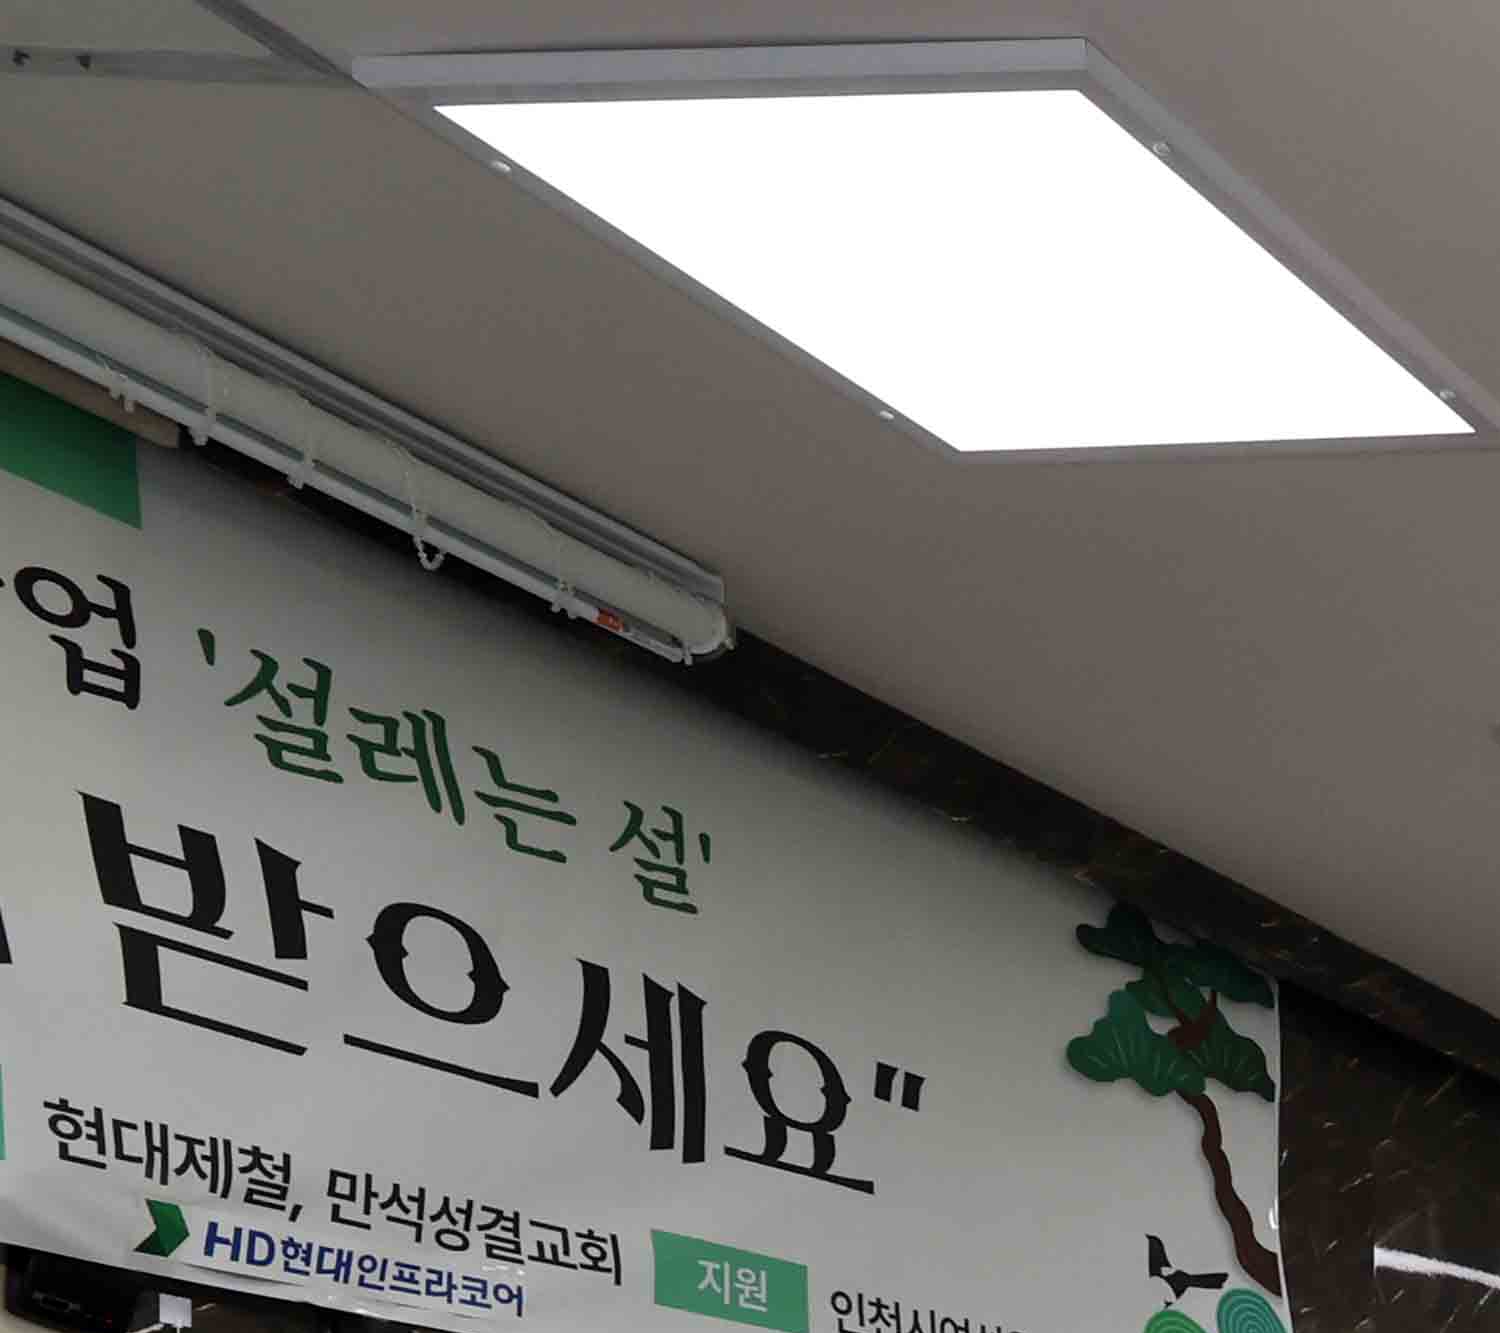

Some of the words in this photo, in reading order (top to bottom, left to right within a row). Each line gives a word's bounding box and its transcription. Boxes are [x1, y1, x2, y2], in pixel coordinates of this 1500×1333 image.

[0, 566, 141, 710] 업
[197, 627, 577, 863] '설레는
[609, 800, 711, 914] 설'
[76, 790, 927, 1195] 받으세요"
[42, 1096, 303, 1222] 현대제철,
[326, 1169, 623, 1286] 만석성결교회
[203, 1220, 526, 1317] HD현대인프라코어
[697, 1258, 768, 1313] 지원
